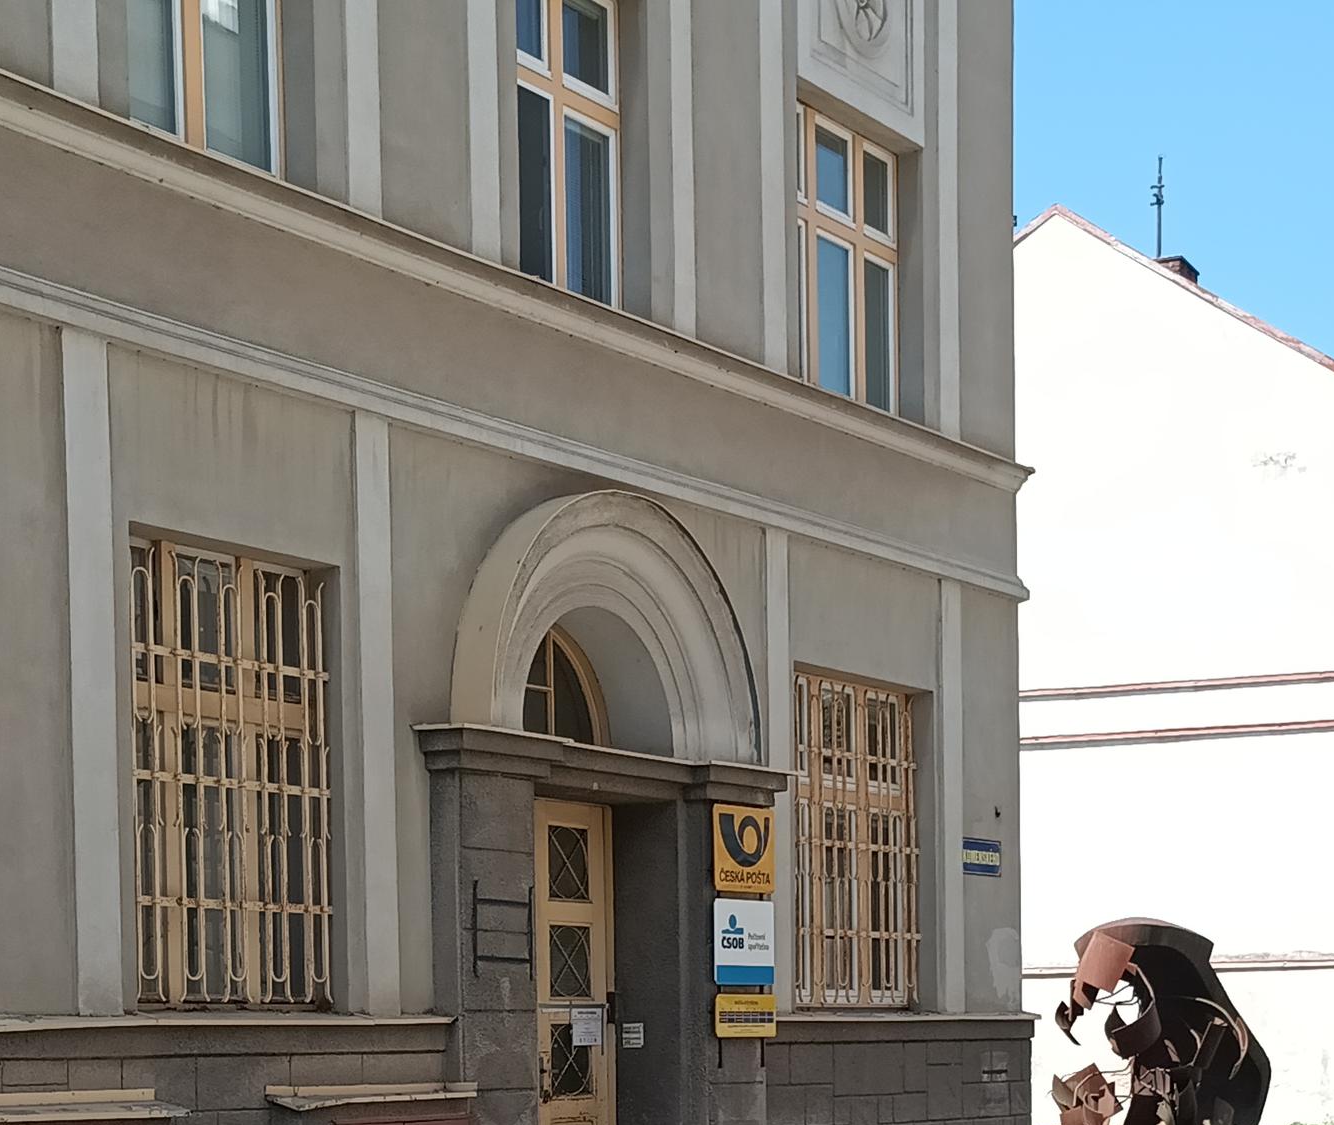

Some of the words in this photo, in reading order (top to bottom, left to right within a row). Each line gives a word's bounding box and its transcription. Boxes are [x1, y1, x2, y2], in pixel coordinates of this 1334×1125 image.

[719, 867, 745, 883] ČESKÁ
[746, 870, 771, 885] POŠTA
[721, 936, 744, 949] ČSOB
